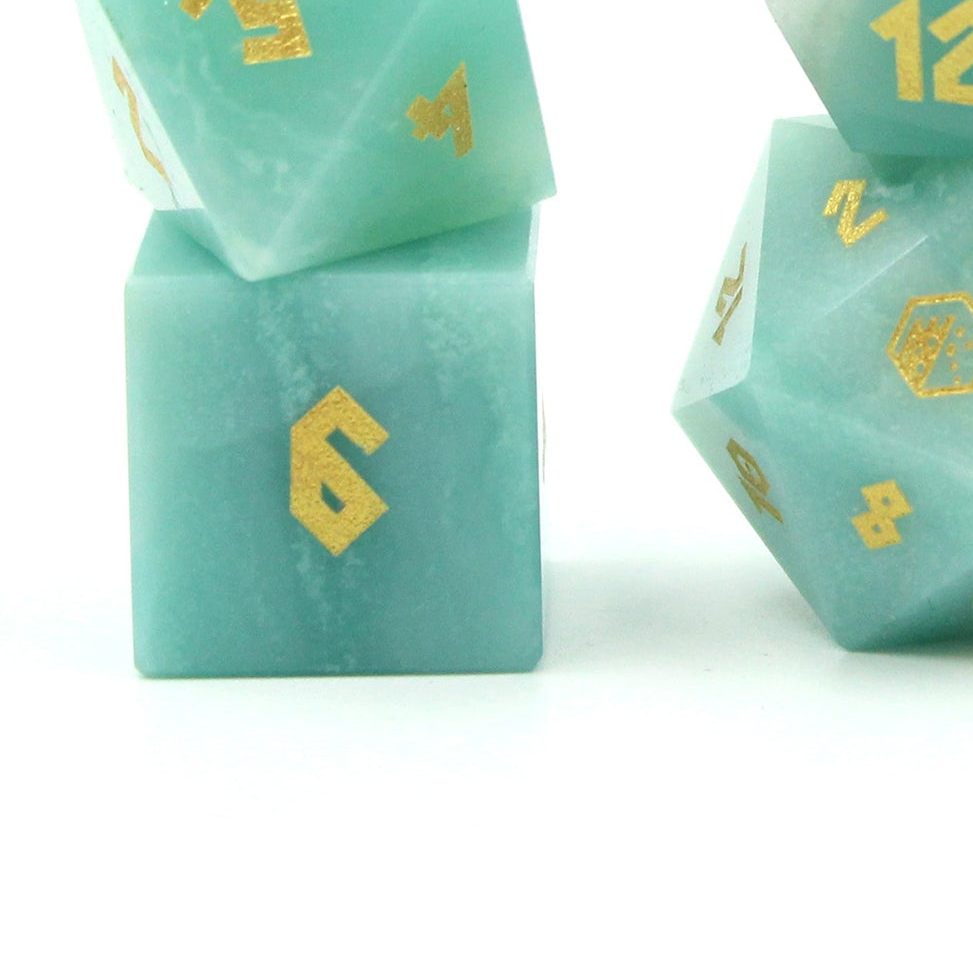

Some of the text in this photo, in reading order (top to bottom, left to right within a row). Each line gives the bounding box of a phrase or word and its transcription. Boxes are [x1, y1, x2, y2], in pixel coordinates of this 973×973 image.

[406, 61, 474, 158] 4
[822, 179, 889, 248] 2
[288, 384, 390, 557] 6
[851, 479, 913, 550] 8
